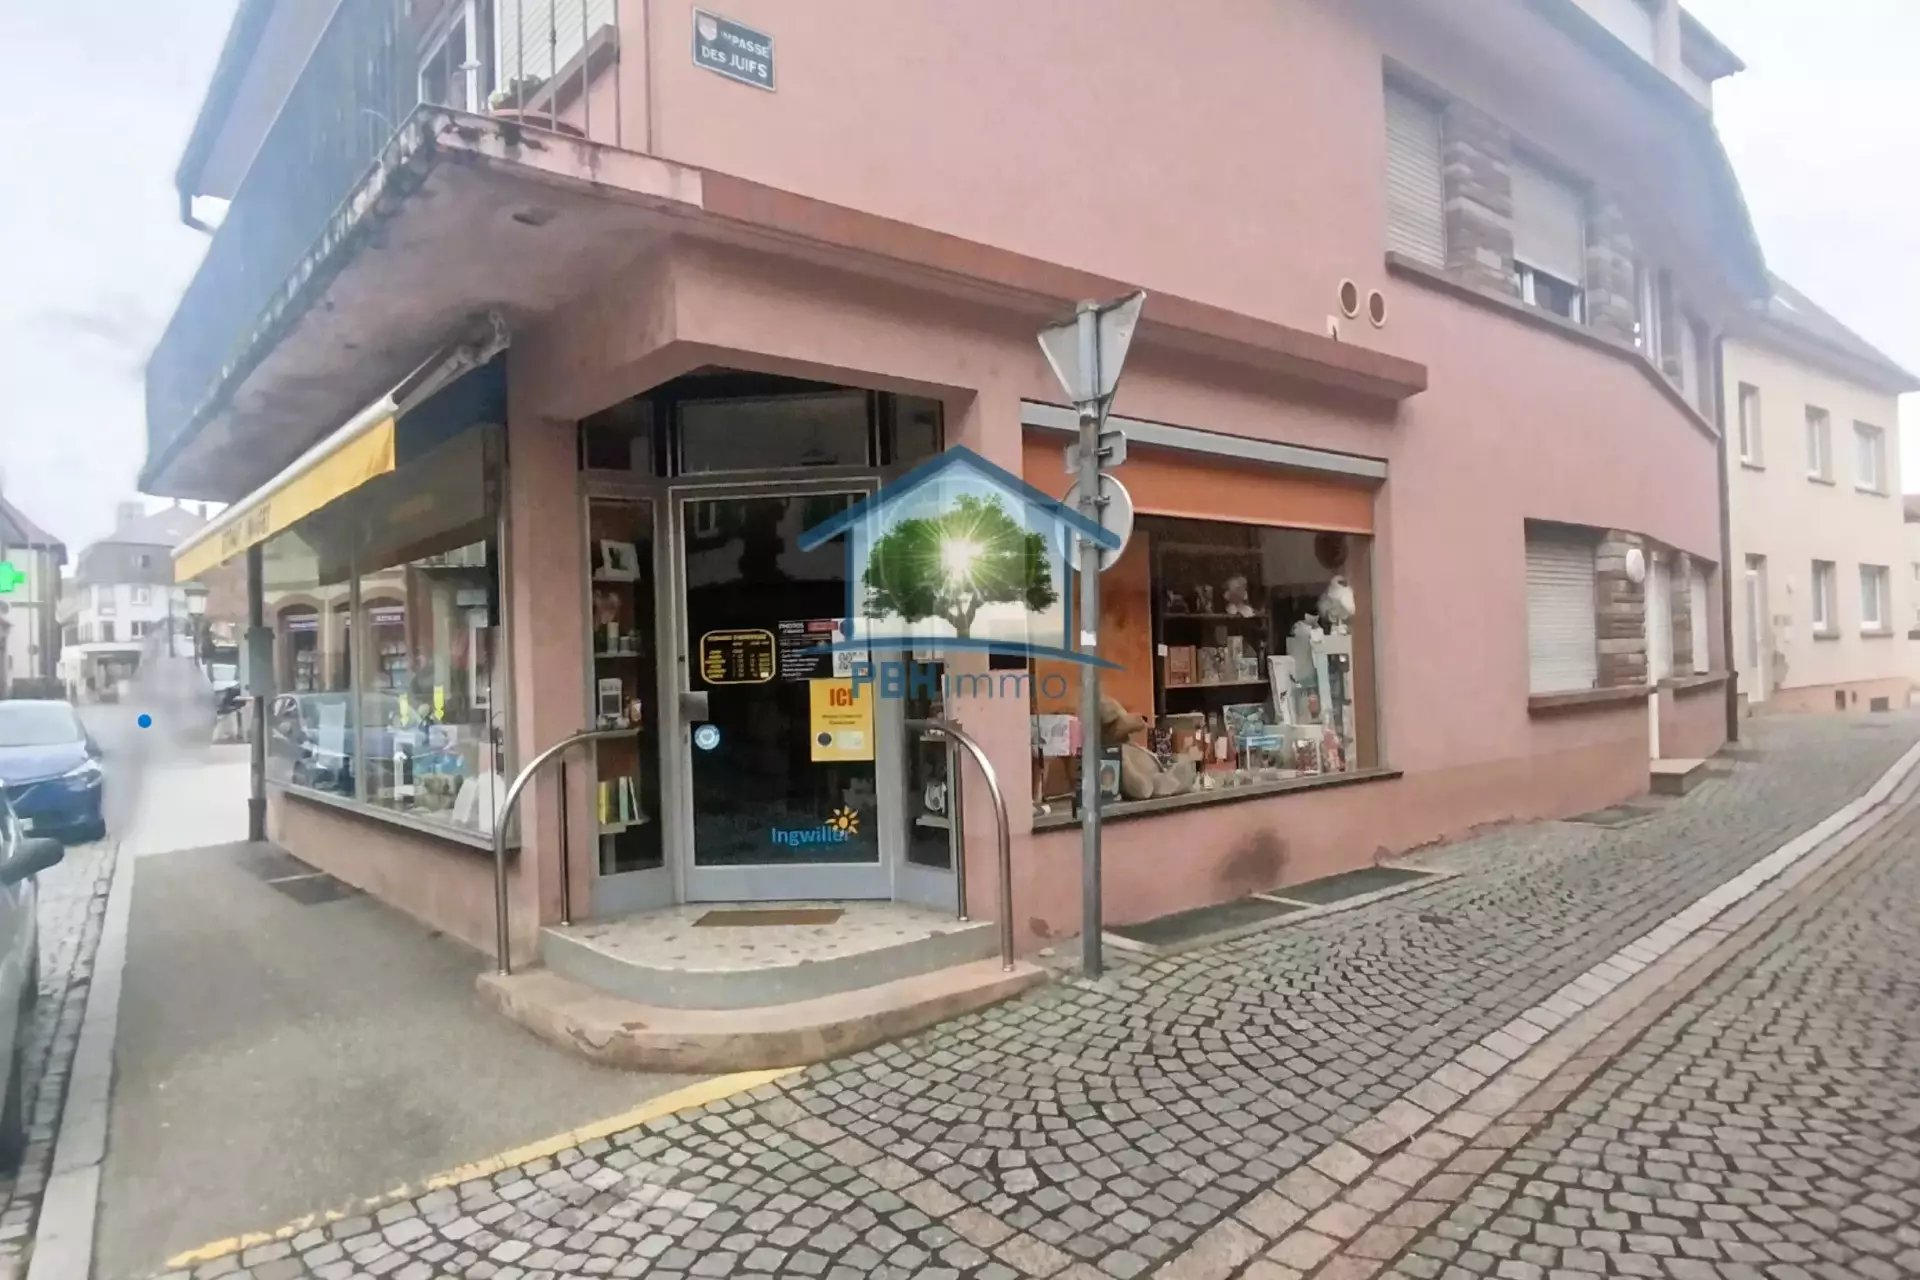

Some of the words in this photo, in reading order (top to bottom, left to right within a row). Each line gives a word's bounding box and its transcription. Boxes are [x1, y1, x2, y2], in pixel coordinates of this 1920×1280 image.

[701, 45, 727, 63] DES
[729, 54, 768, 78] JUIFS
[829, 688, 855, 707] ICI
[772, 826, 849, 846] Ingwiller
